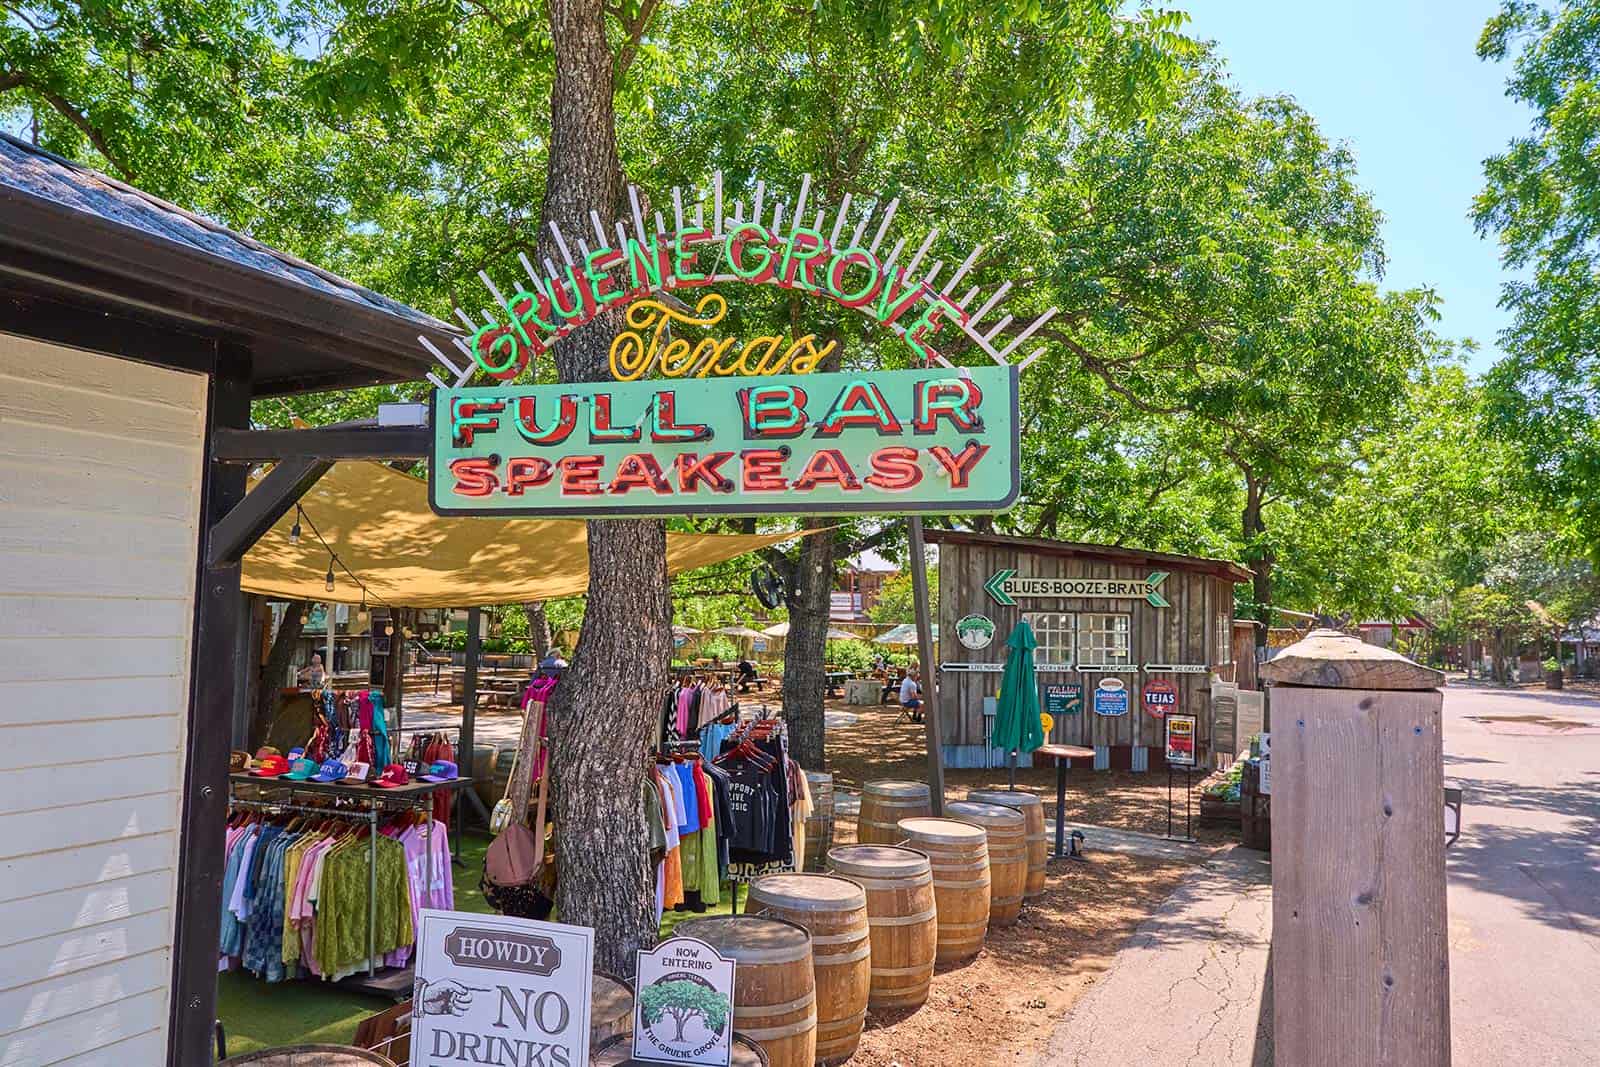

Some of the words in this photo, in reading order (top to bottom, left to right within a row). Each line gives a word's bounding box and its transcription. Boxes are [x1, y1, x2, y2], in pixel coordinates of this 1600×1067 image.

[471, 227, 711, 379] GRUENE
[726, 222, 969, 360] GROVE
[609, 294, 836, 381] Texas
[450, 389, 714, 447] FULL
[737, 378, 985, 440] BAR
[449, 444, 991, 497] SPEAKEASY
[1145, 693, 1175, 704] TEJAS
[729, 782, 755, 796] PPORT
[457, 936, 549, 968] HOWDY
[662, 957, 713, 970] ENTERING
[676, 947, 700, 958] NOW
[492, 985, 571, 1036] NO
[429, 1028, 571, 1067] DRINKS
[645, 1028, 660, 1046] THE
[658, 1043, 693, 1058] GRUENE
[693, 1034, 721, 1057] GROVE
